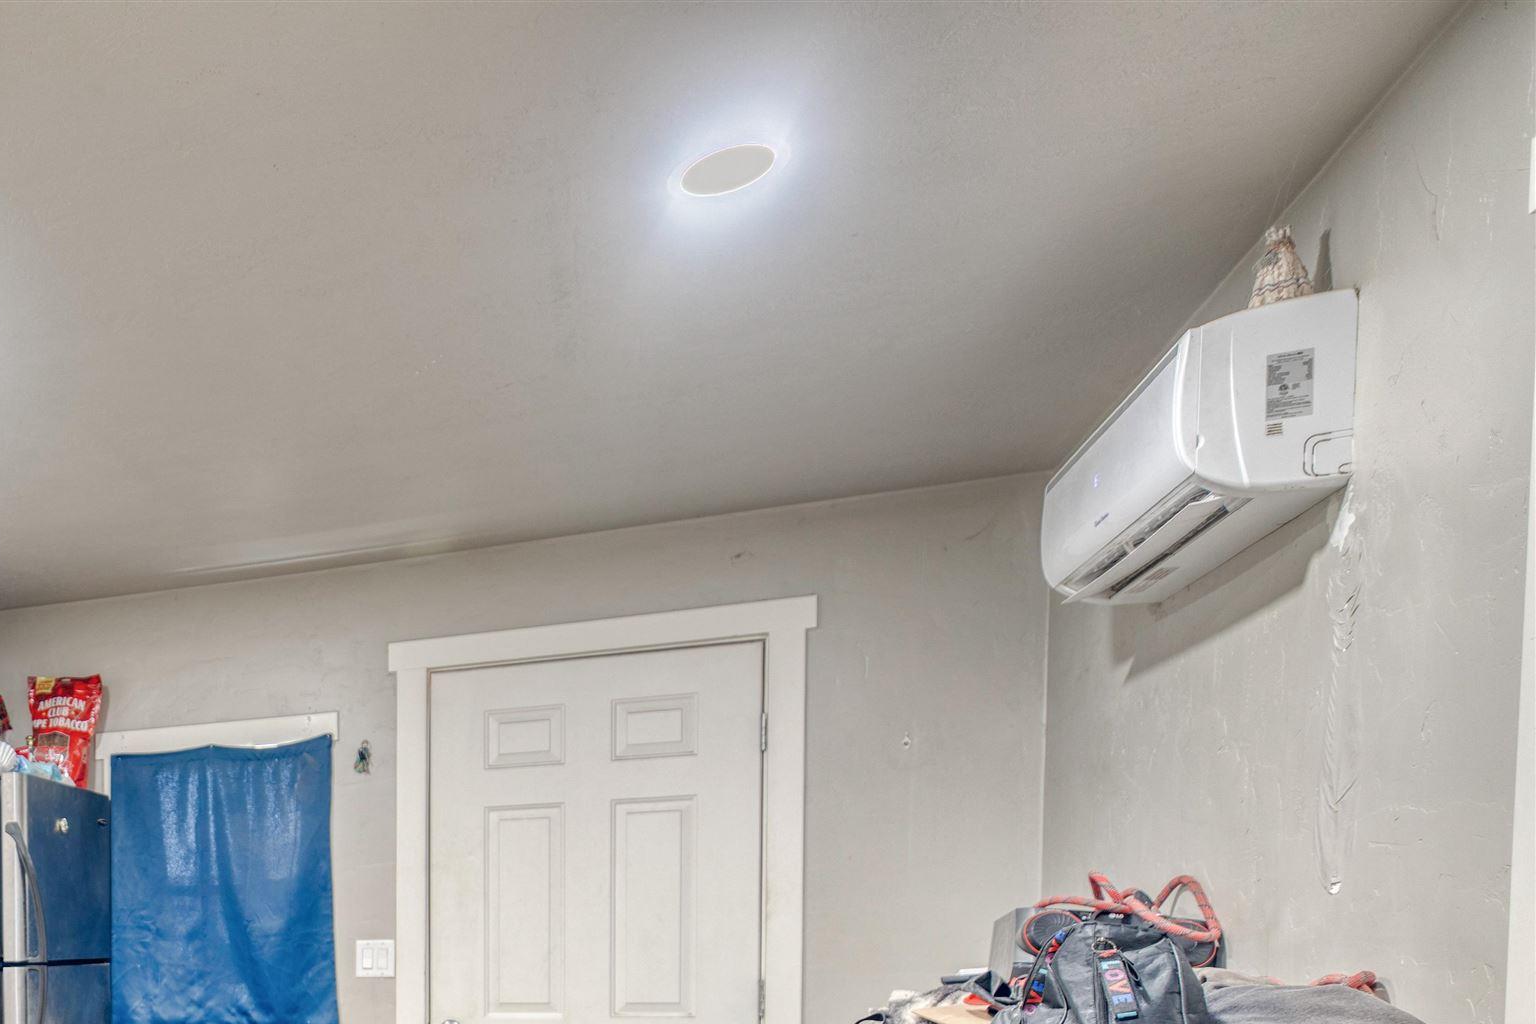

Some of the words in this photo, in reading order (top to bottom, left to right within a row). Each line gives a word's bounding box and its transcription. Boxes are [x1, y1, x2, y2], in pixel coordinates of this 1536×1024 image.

[37, 696, 86, 712] AMERICAN
[47, 706, 69, 718] CLUB
[32, 718, 48, 729] IPE
[49, 717, 89, 732] TOBACCO
[1100, 960, 1135, 1005] LOVE
